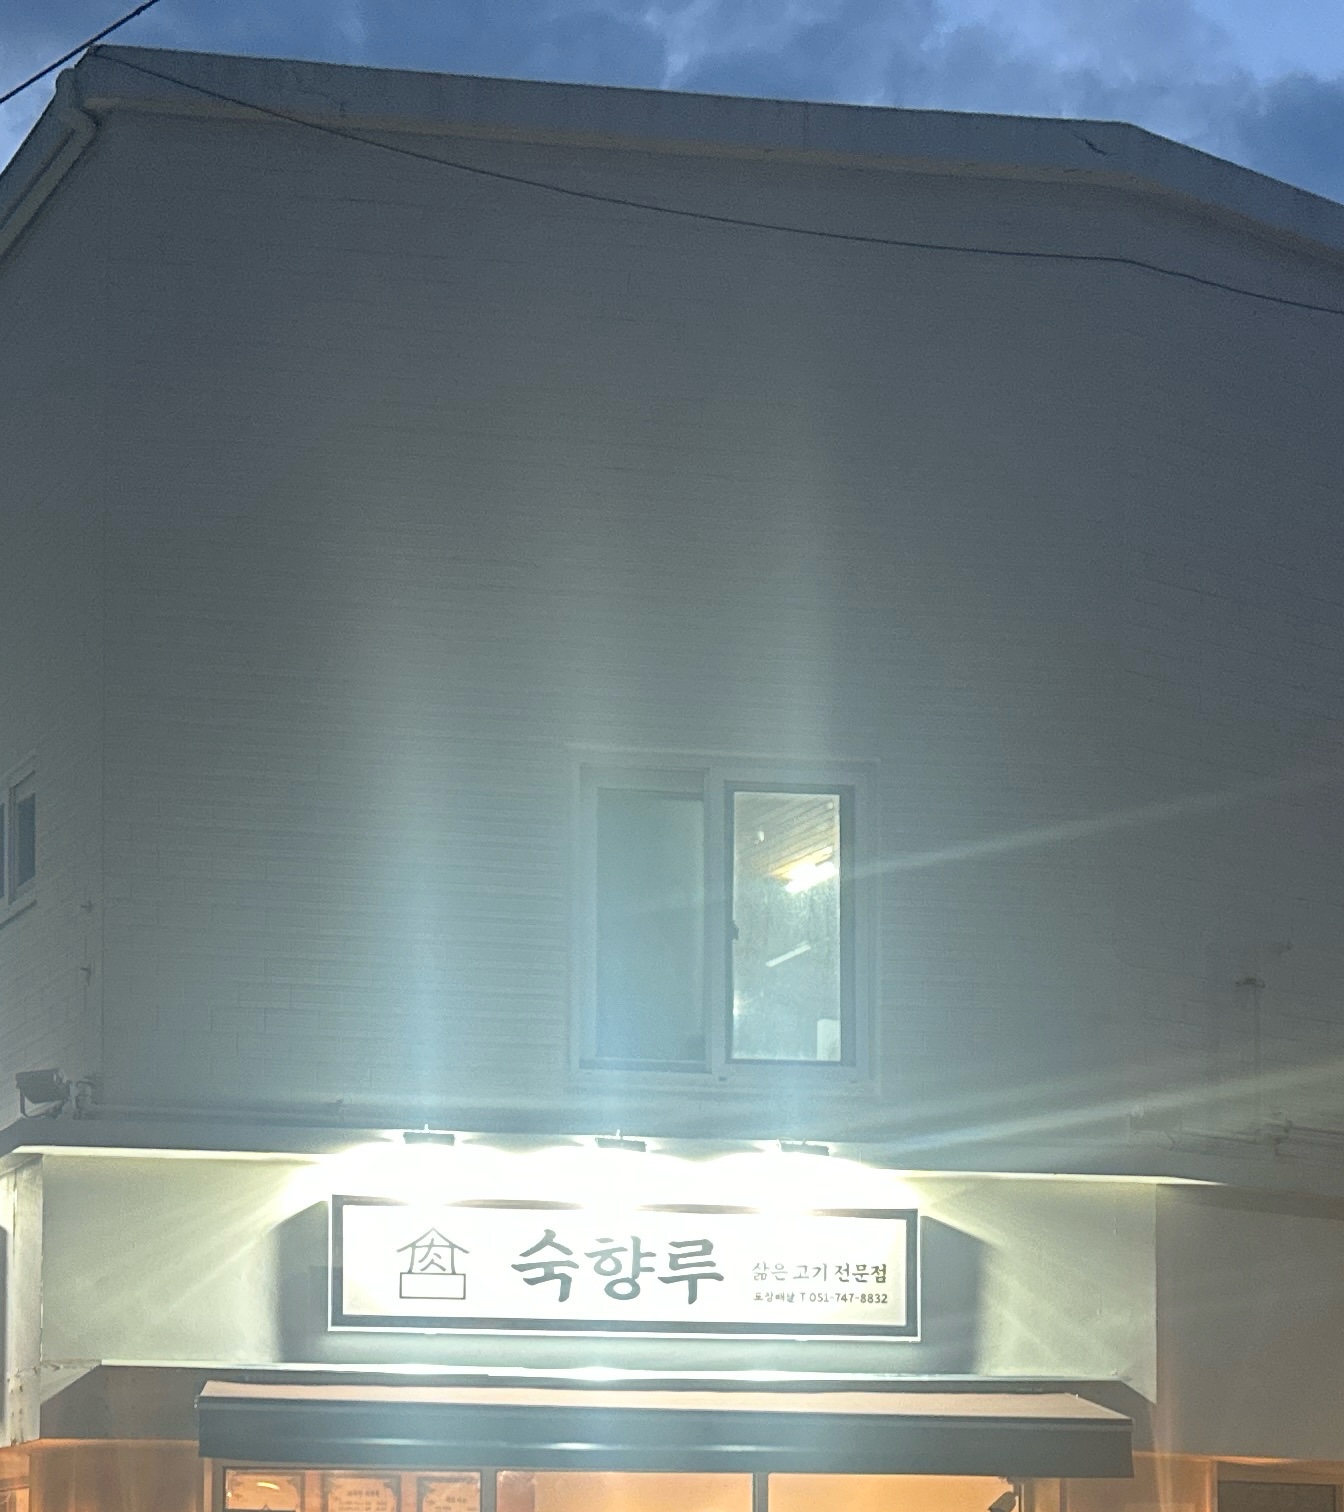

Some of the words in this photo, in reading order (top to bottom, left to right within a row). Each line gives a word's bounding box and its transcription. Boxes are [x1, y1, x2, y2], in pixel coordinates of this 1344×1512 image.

[511, 1228, 725, 1305] 숙향루
[752, 1261, 788, 1281] 삶은
[793, 1262, 828, 1281] 고기
[835, 1262, 887, 1283] 전문점
[809, 1293, 888, 1304] 051-747-8832
